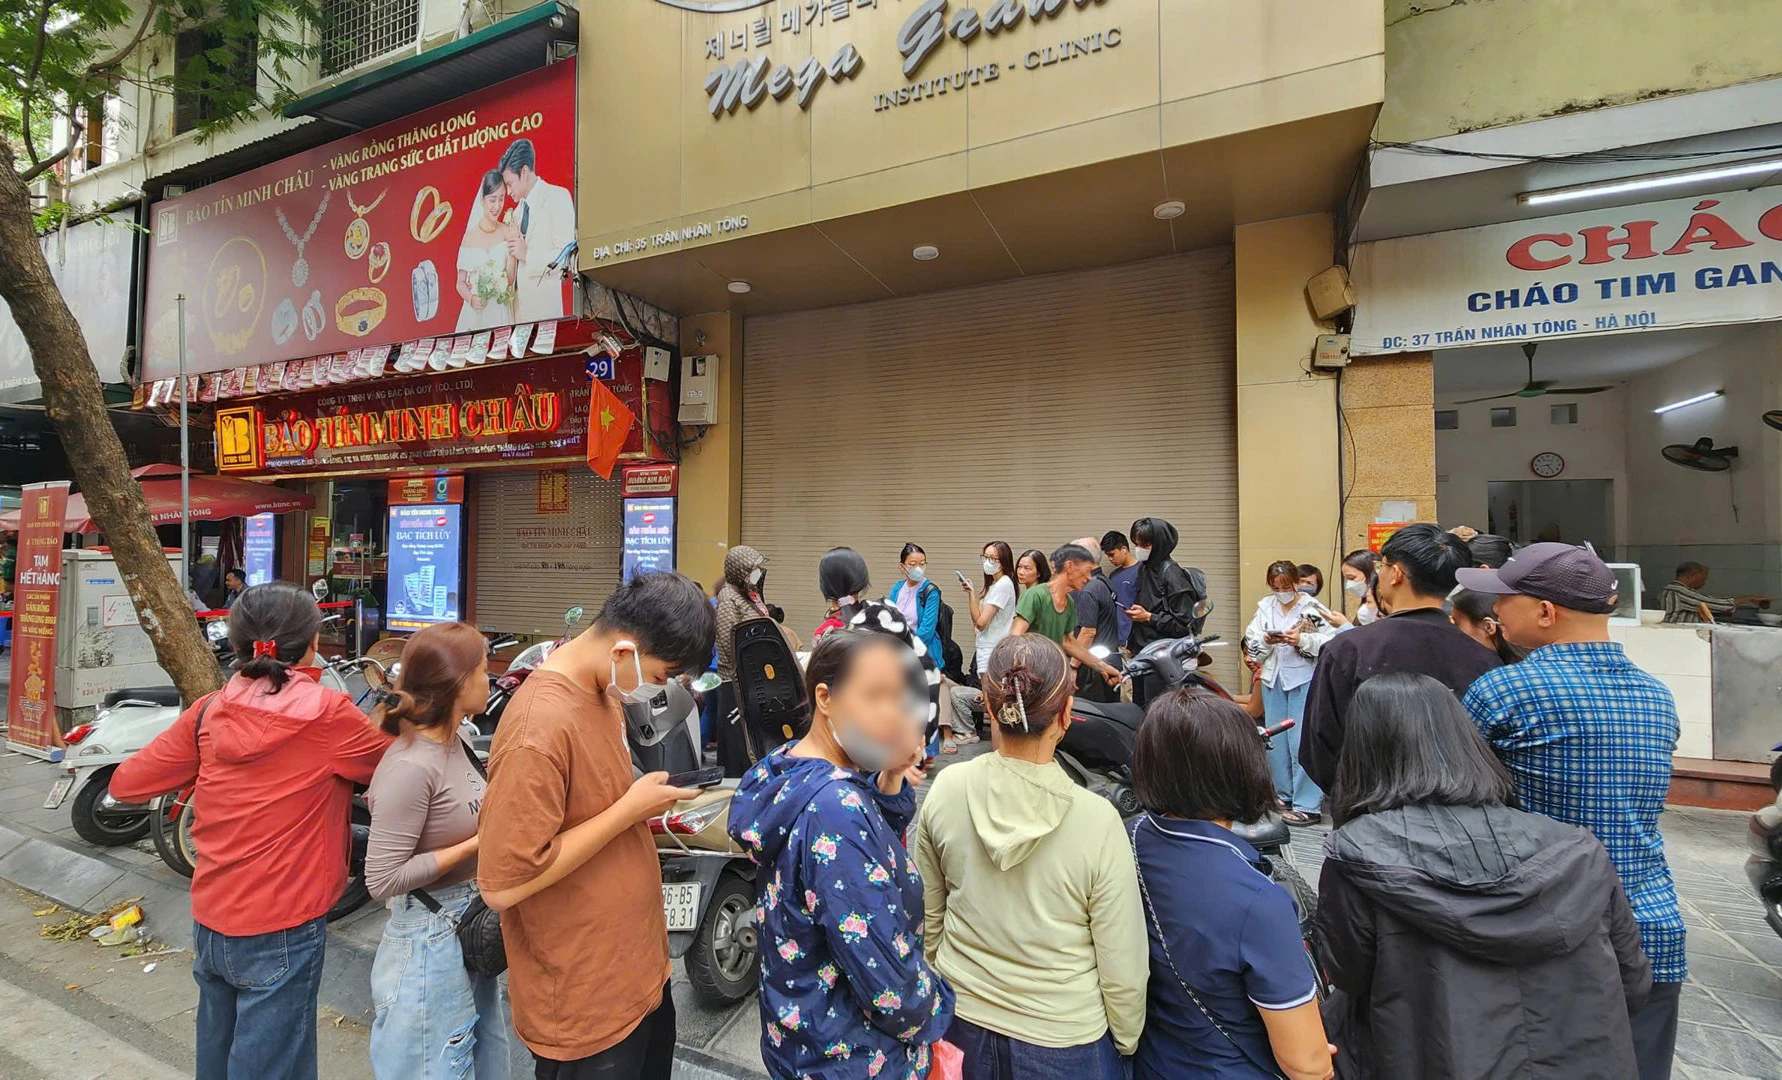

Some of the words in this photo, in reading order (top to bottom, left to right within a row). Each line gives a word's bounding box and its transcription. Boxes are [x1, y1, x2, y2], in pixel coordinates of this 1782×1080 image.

[704, 41, 864, 119] Mega
[874, 62, 999, 112] INSTITUTE
[1023, 27, 1122, 70] CLINIC
[328, 169, 358, 193] VÀNG
[359, 157, 398, 184] TRANG
[400, 146, 424, 172] SỨC
[426, 135, 459, 164] CHẤT
[460, 122, 508, 153] LƯỢNG
[510, 111, 544, 139] CAO
[329, 148, 359, 172] VÀNG
[361, 138, 394, 164] RỒNG
[396, 125, 437, 155] THĂNG
[440, 110, 476, 138] LONG
[212, 192, 235, 218] TÍN
[236, 184, 272, 213] MINH
[274, 169, 314, 200] CHÂU
[635, 237, 647, 250] 35
[681, 222, 712, 241] NHÂN
[715, 214, 749, 233] TÔNG
[1467, 281, 1579, 313] CHÁO
[1594, 271, 1676, 300] TIM
[1382, 336, 1407, 349] ĐC:
[1412, 333, 1430, 347] 37
[1481, 322, 1527, 340] NHÂN
[1533, 318, 1576, 335] TÔNG
[1595, 312, 1619, 330] HÀ
[1625, 310, 1656, 330] NỘI
[589, 360, 608, 377] 29
[263, 409, 315, 454] BẢO
[316, 406, 363, 448] TÍN
[364, 403, 453, 443] MINH
[459, 383, 558, 437] CHÂU
